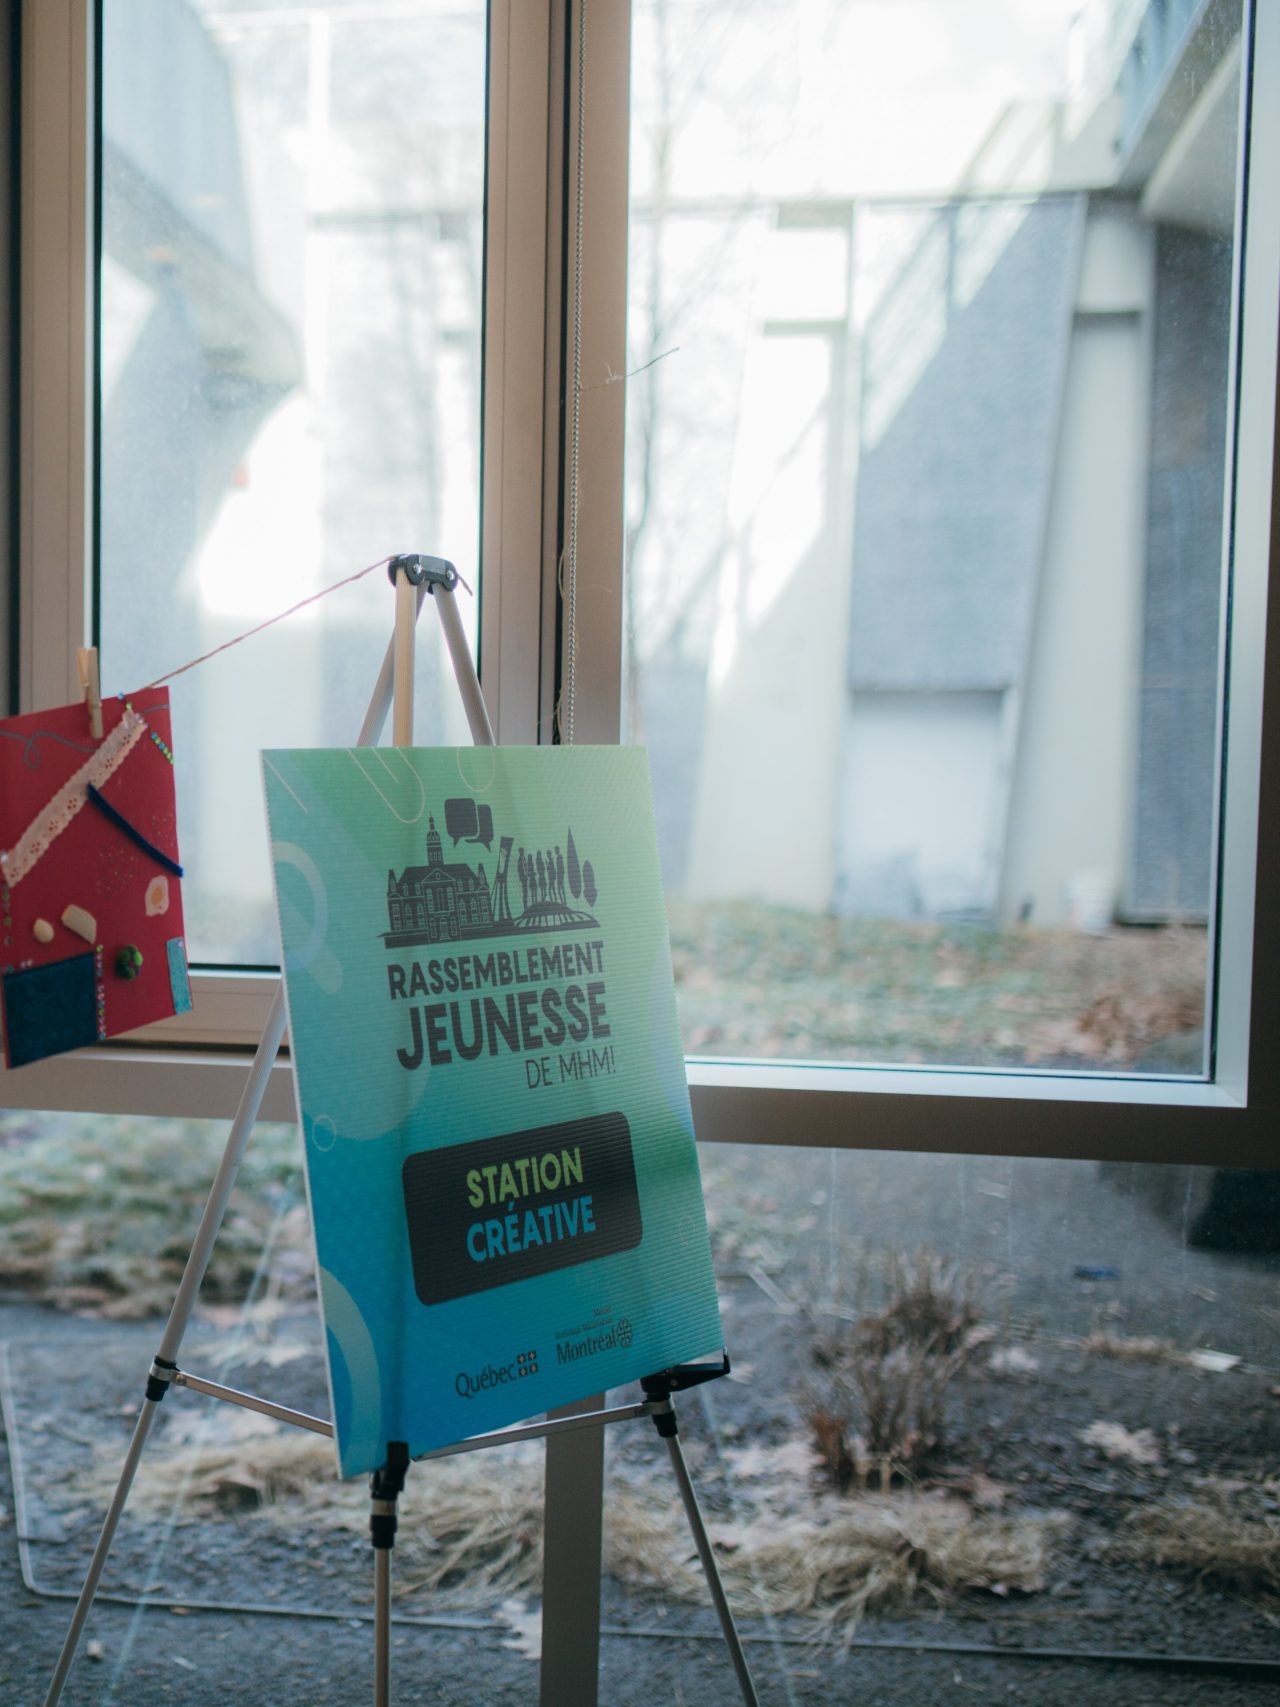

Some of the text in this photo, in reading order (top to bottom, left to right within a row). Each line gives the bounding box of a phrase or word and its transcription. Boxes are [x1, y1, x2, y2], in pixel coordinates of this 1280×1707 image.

[387, 940, 604, 1000] RASSEMBLEMENT
[396, 981, 611, 1071] JEUNESSE
[525, 1045, 617, 1090] DE MHM!
[466, 1147, 584, 1209] STATION
[466, 1195, 596, 1263] CRÉATIVE
[556, 1326, 617, 1365] Montréal
[455, 1363, 517, 1399] Québec
